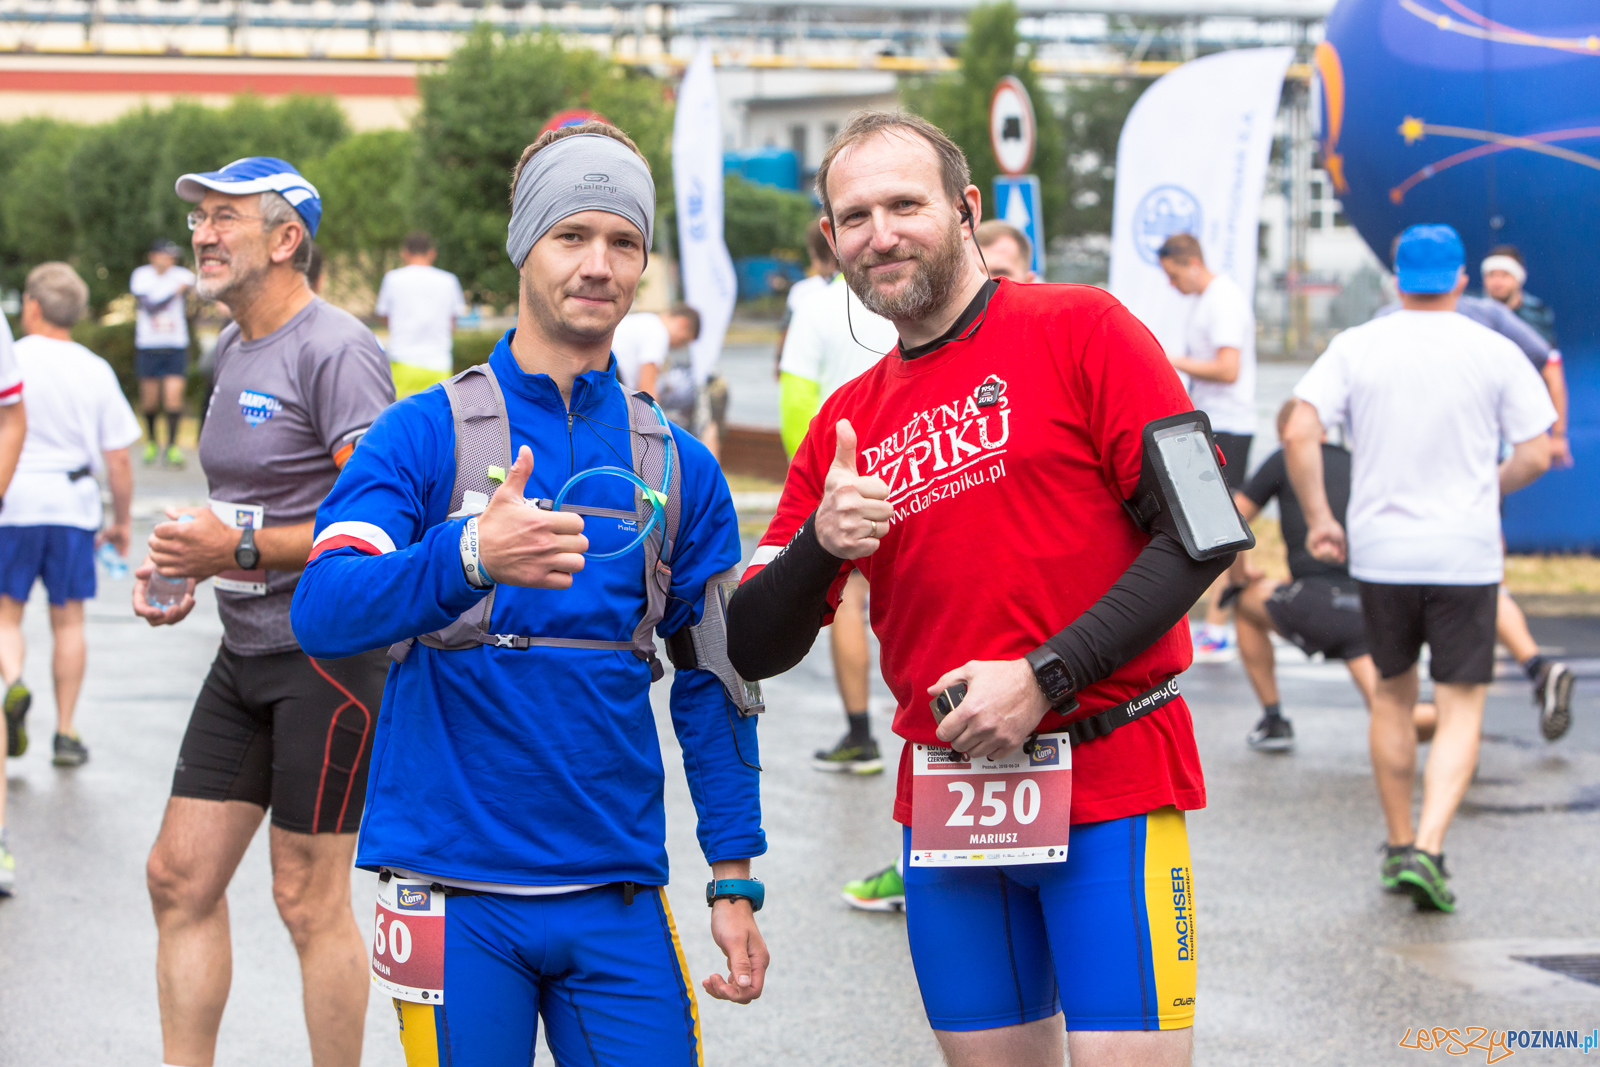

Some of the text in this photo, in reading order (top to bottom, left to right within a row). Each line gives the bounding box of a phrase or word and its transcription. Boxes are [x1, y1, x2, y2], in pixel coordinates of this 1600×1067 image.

[862, 396, 980, 473] DRUŻYNA
[873, 409, 1011, 501] ZPIKU
[1126, 687, 1171, 717] Kalenji
[944, 778, 1041, 827] 250
[969, 832, 1018, 844] MARIUSZ
[404, 894, 422, 903] LOTTO
[1171, 867, 1189, 961] DACHSER
